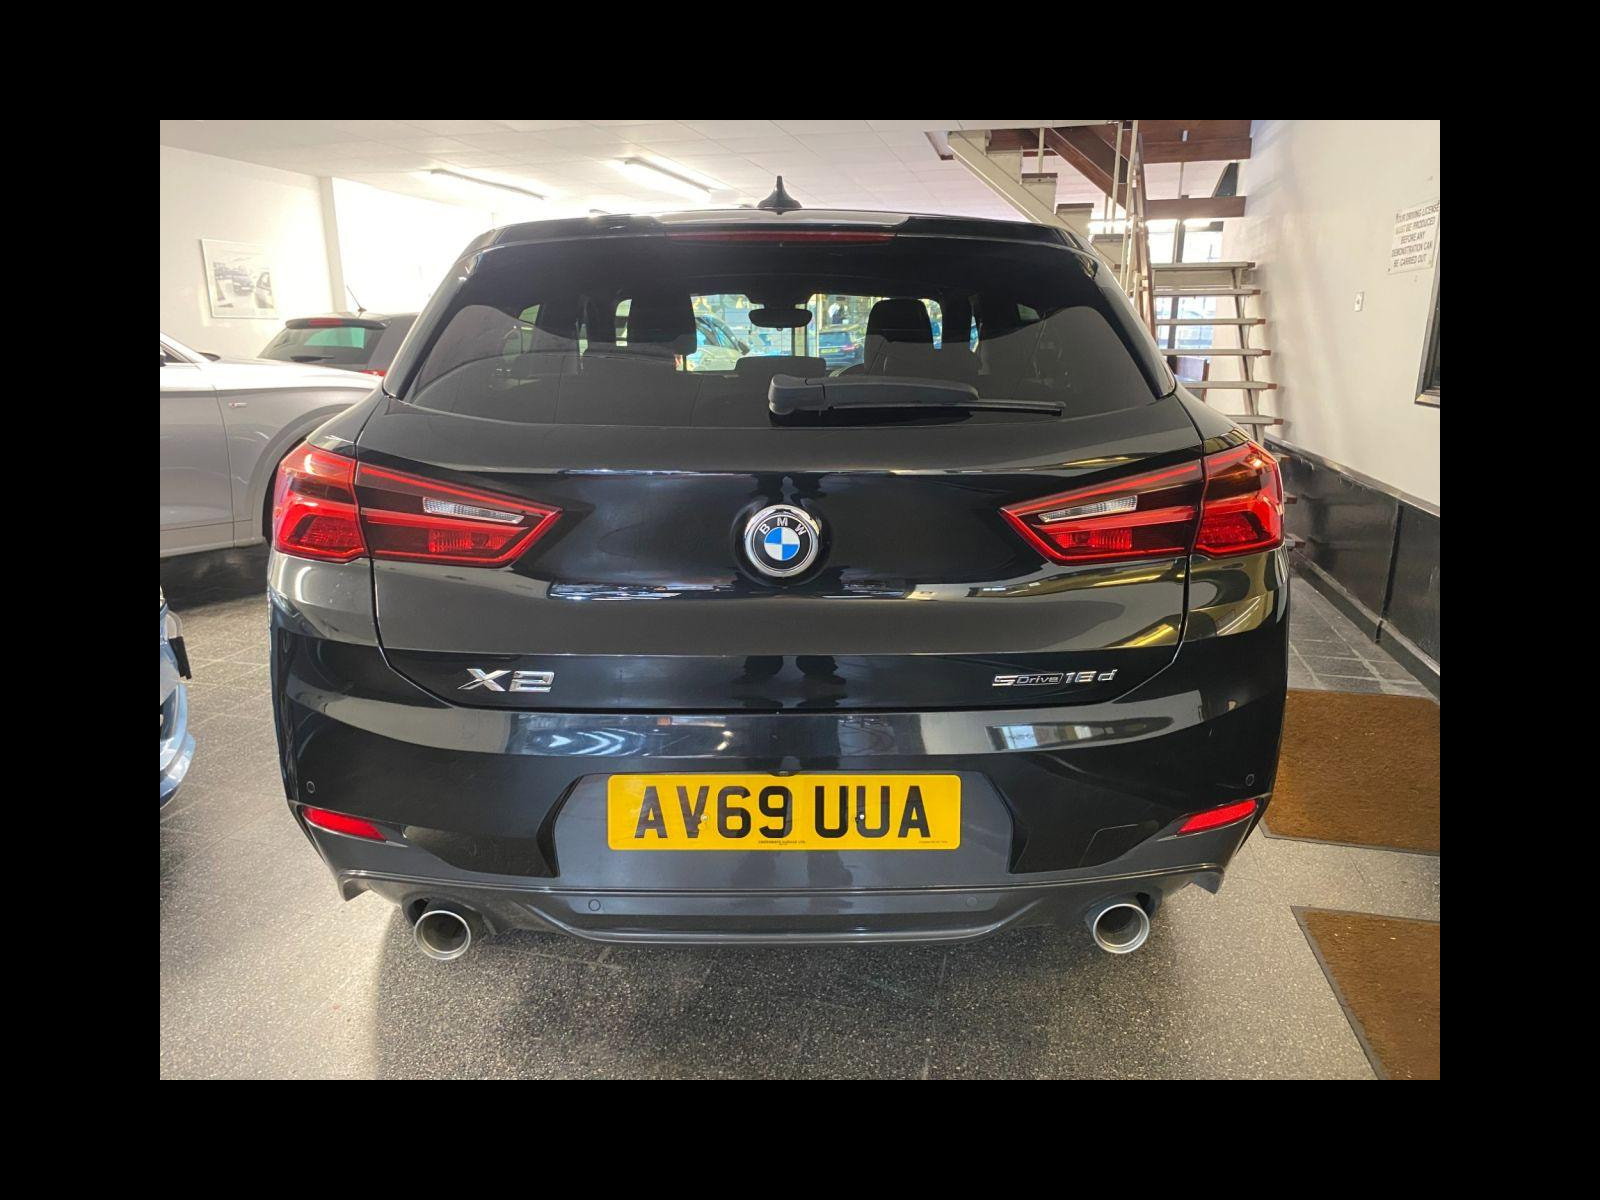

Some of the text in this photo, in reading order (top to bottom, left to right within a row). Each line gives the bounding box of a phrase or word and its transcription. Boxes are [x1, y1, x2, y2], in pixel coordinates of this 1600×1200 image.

[1400, 231, 1426, 244] BEFORE ANY
[1391, 240, 1433, 257] DEMONSTRATION CAN
[1400, 256, 1417, 266] CARRIED
[1418, 253, 1427, 264] OUT
[759, 517, 807, 535] BMW
[457, 668, 555, 692] X2
[634, 785, 931, 839] AV69 UUA
